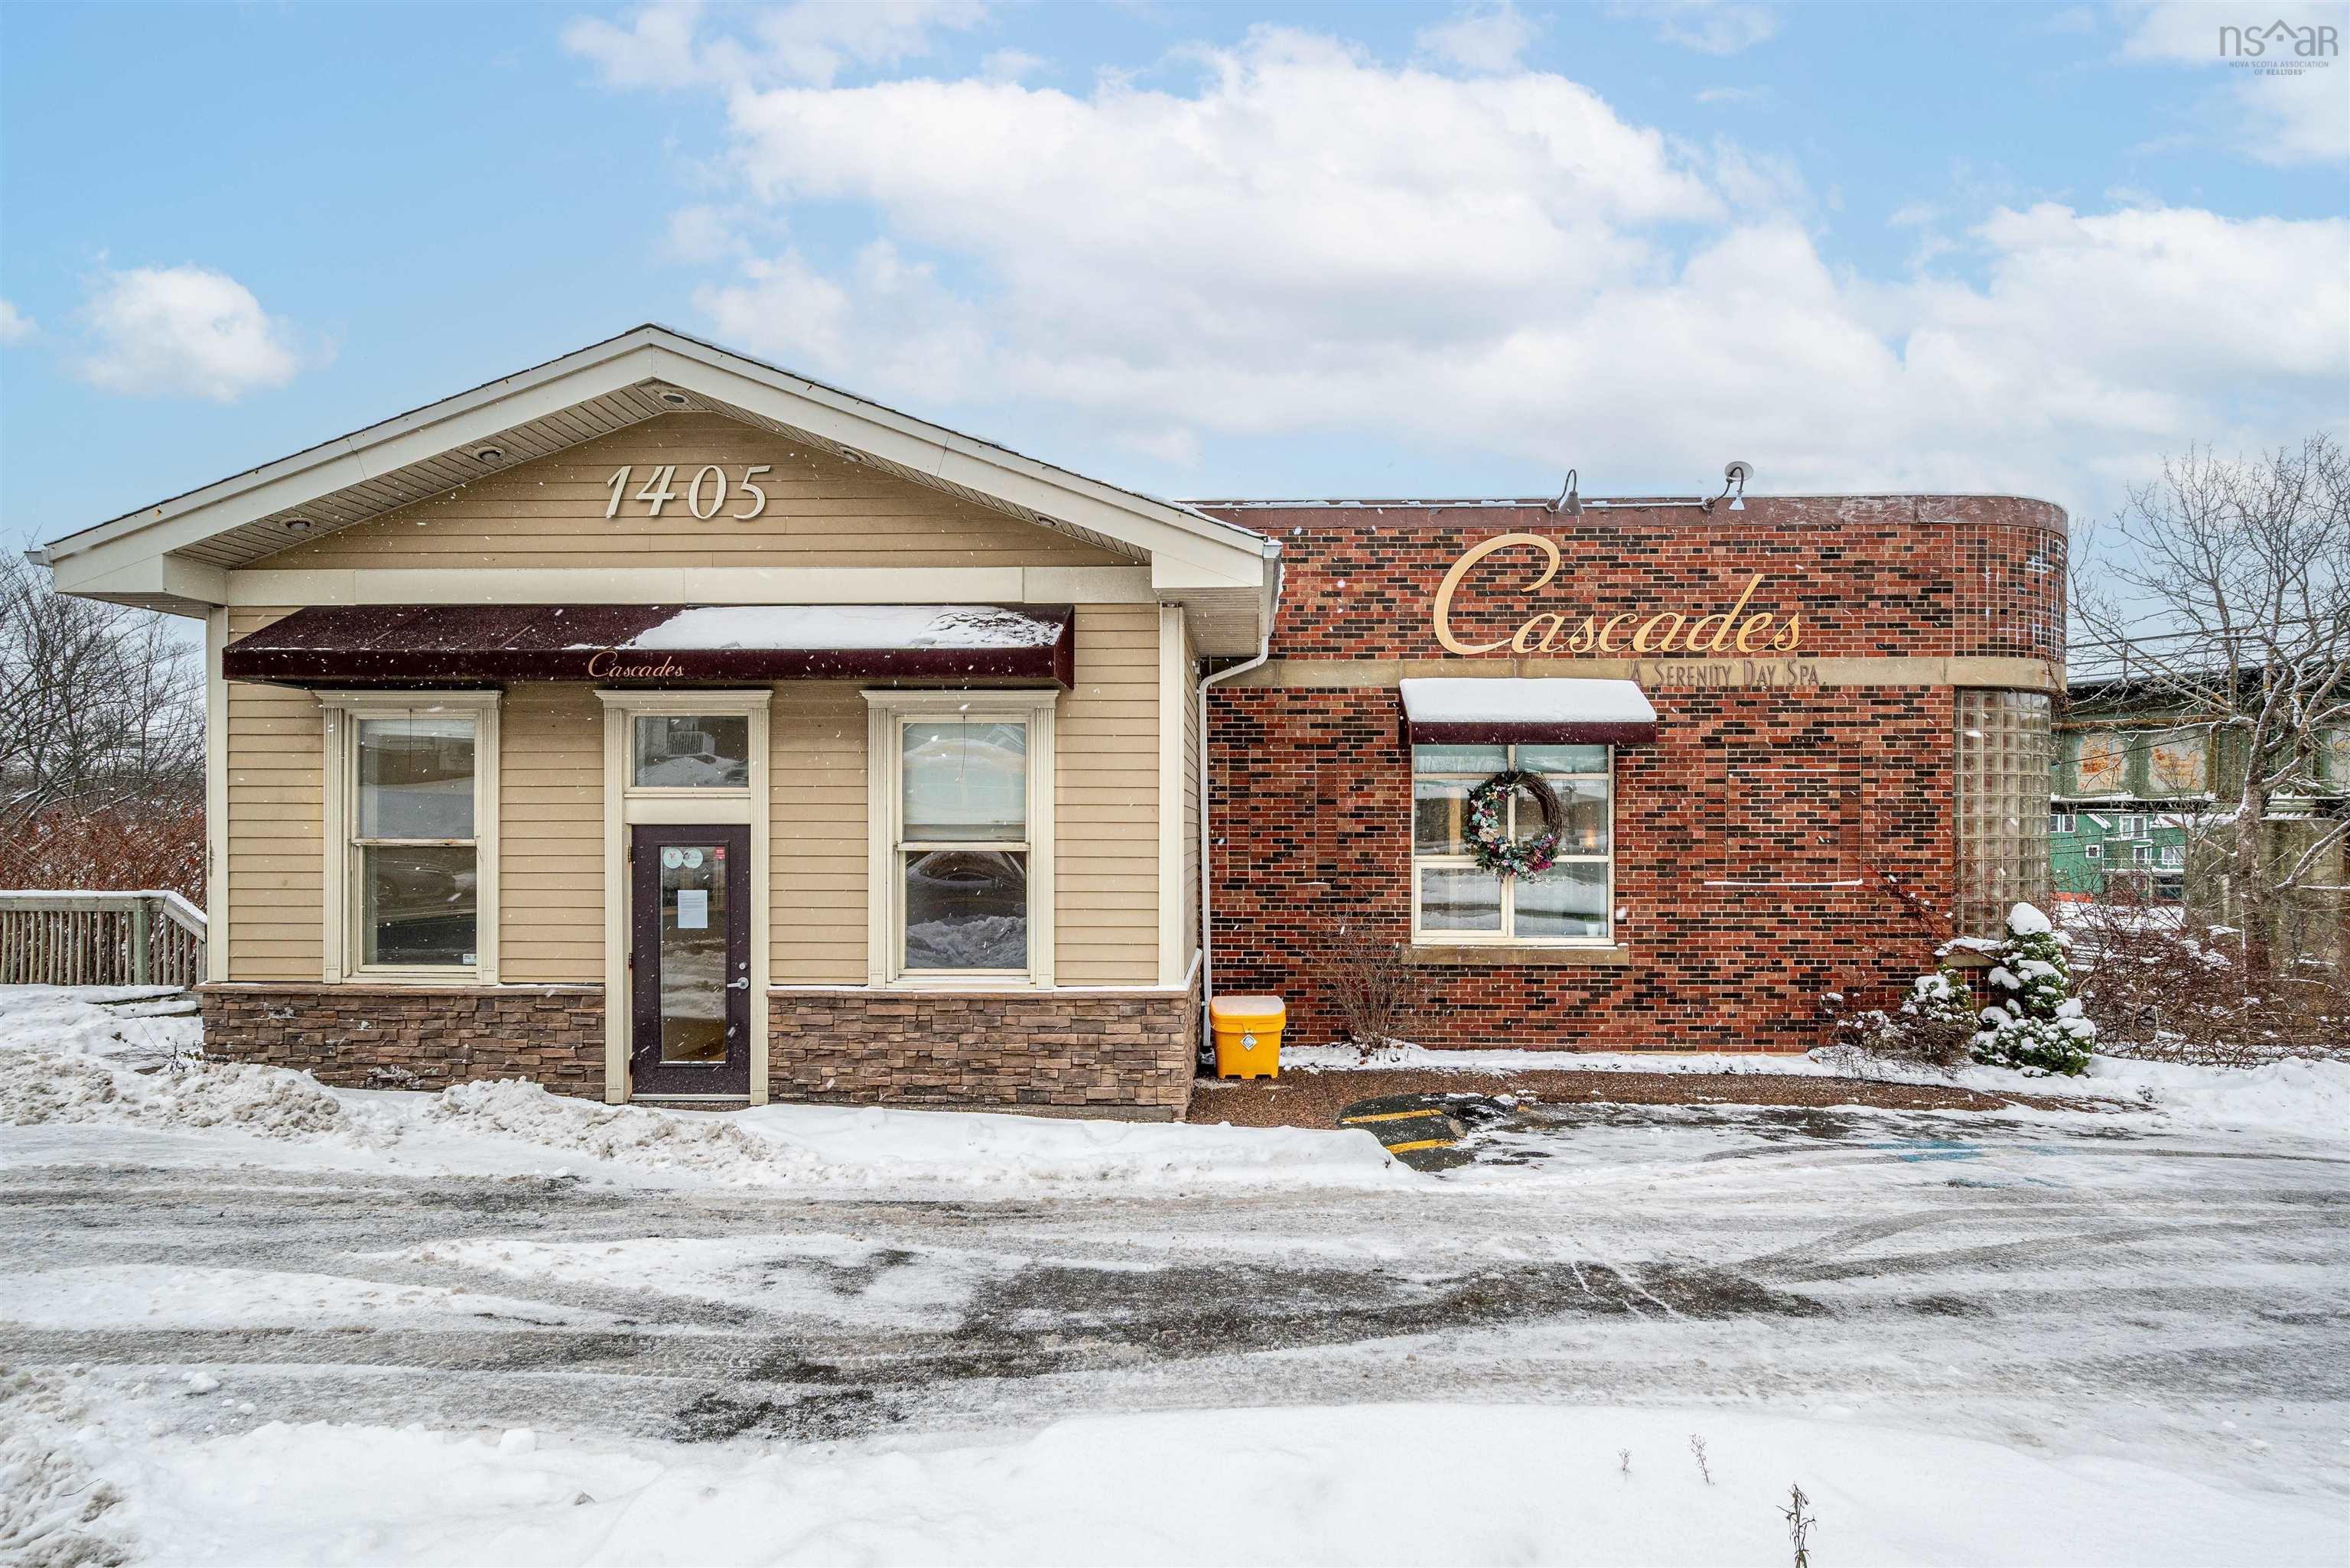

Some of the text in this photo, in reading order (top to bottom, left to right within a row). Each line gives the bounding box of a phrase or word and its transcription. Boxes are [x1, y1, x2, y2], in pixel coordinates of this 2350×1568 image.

[605, 464, 771, 520] 1405
[1433, 532, 1804, 656] Cascades
[588, 650, 685, 678] Cascades
